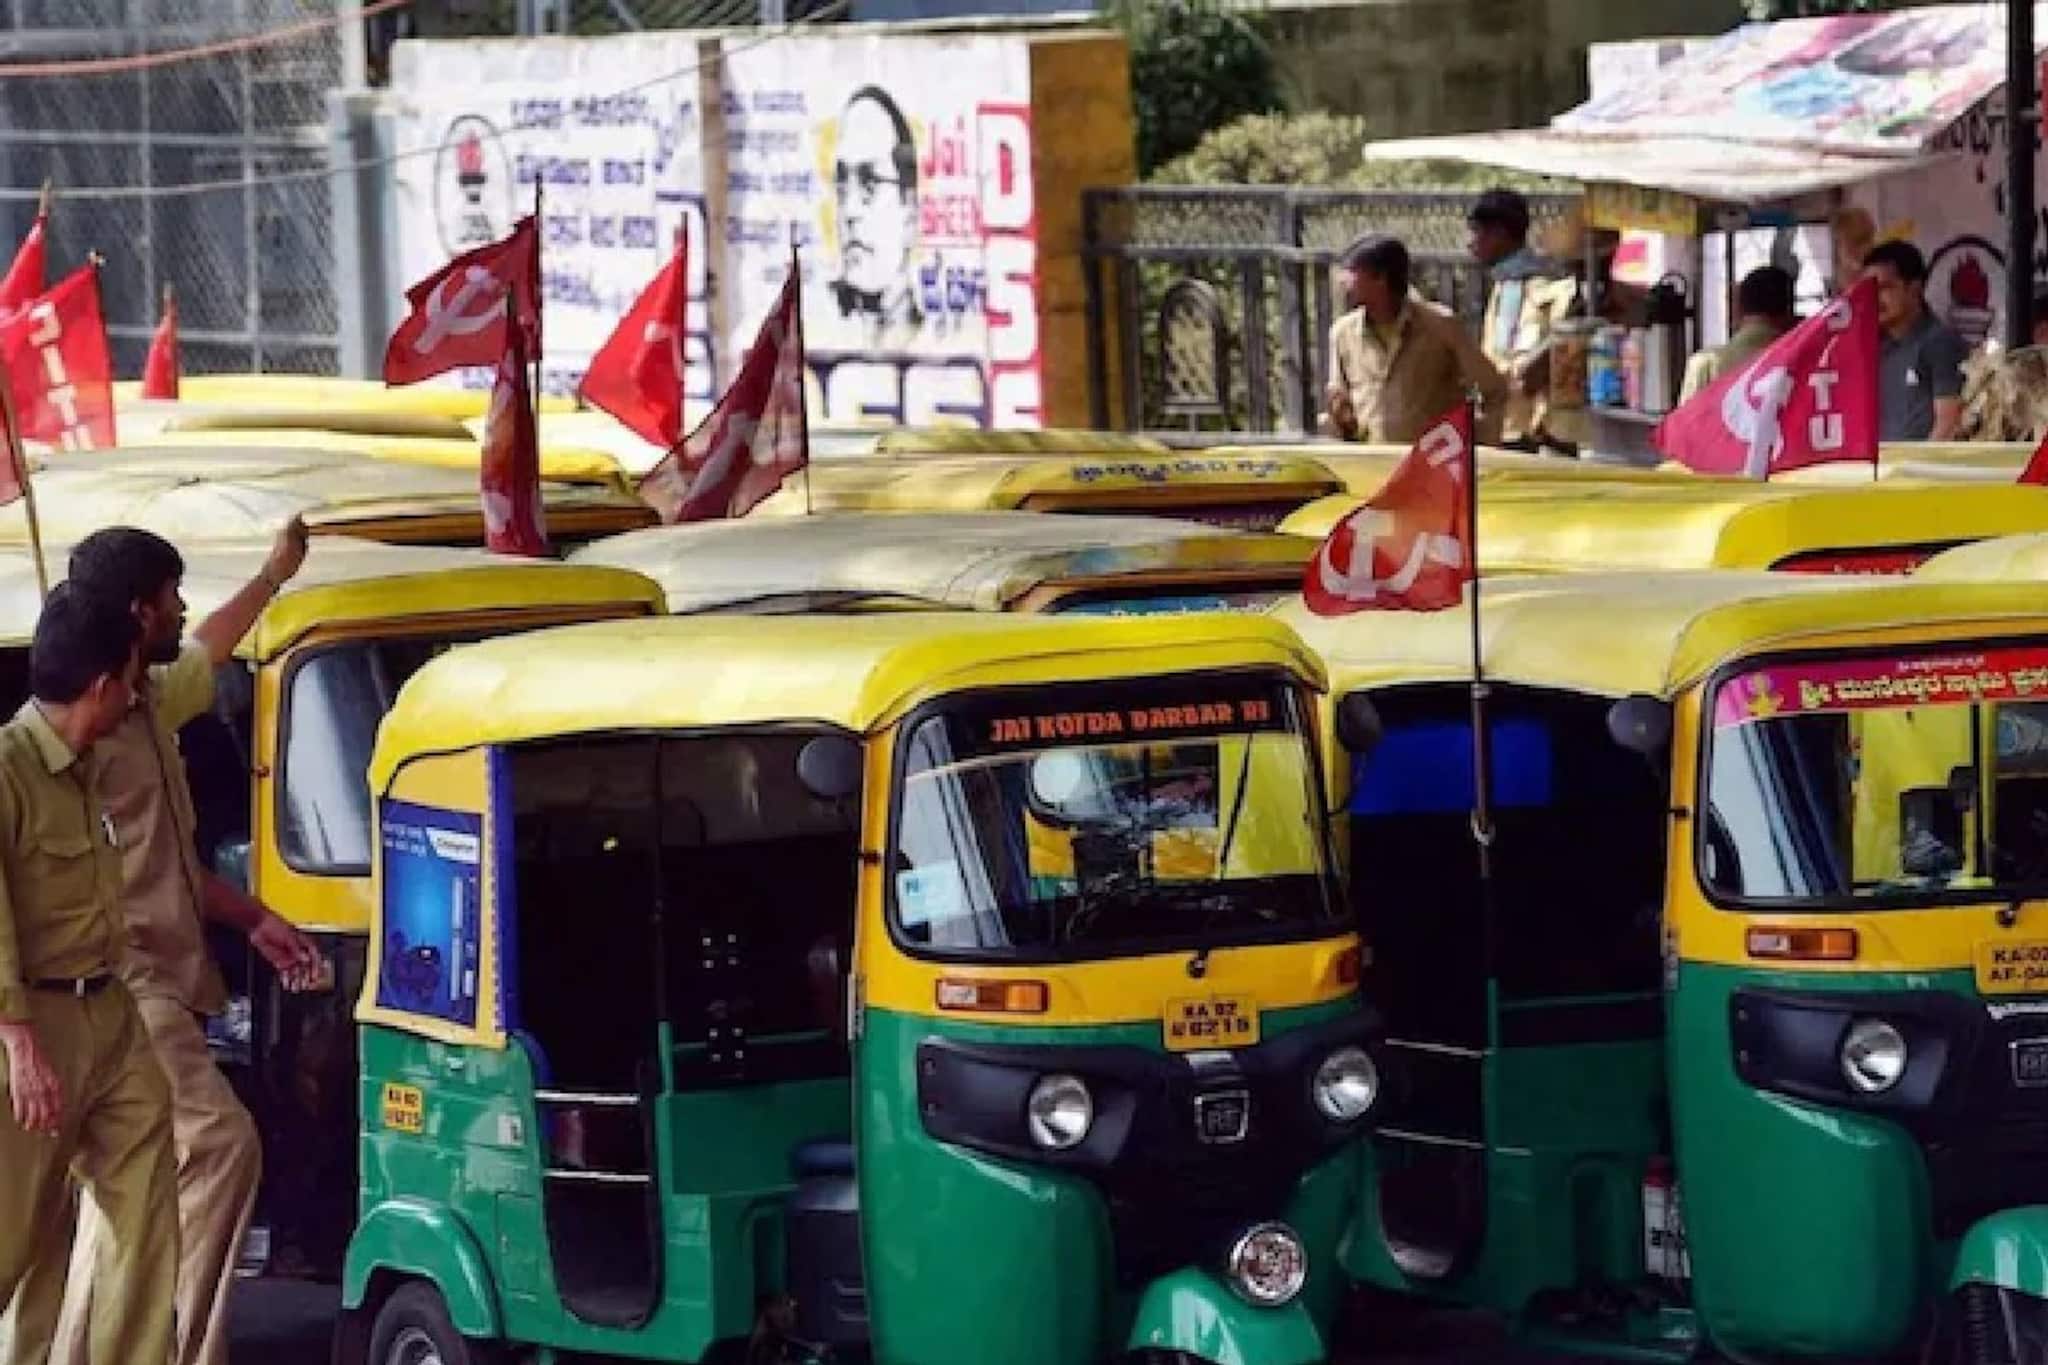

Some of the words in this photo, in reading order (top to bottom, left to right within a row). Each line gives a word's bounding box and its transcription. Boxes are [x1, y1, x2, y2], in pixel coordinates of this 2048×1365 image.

[921, 113, 966, 178] Jai
[989, 718, 1032, 743] JAI
[1128, 702, 1234, 730] DARBAR
